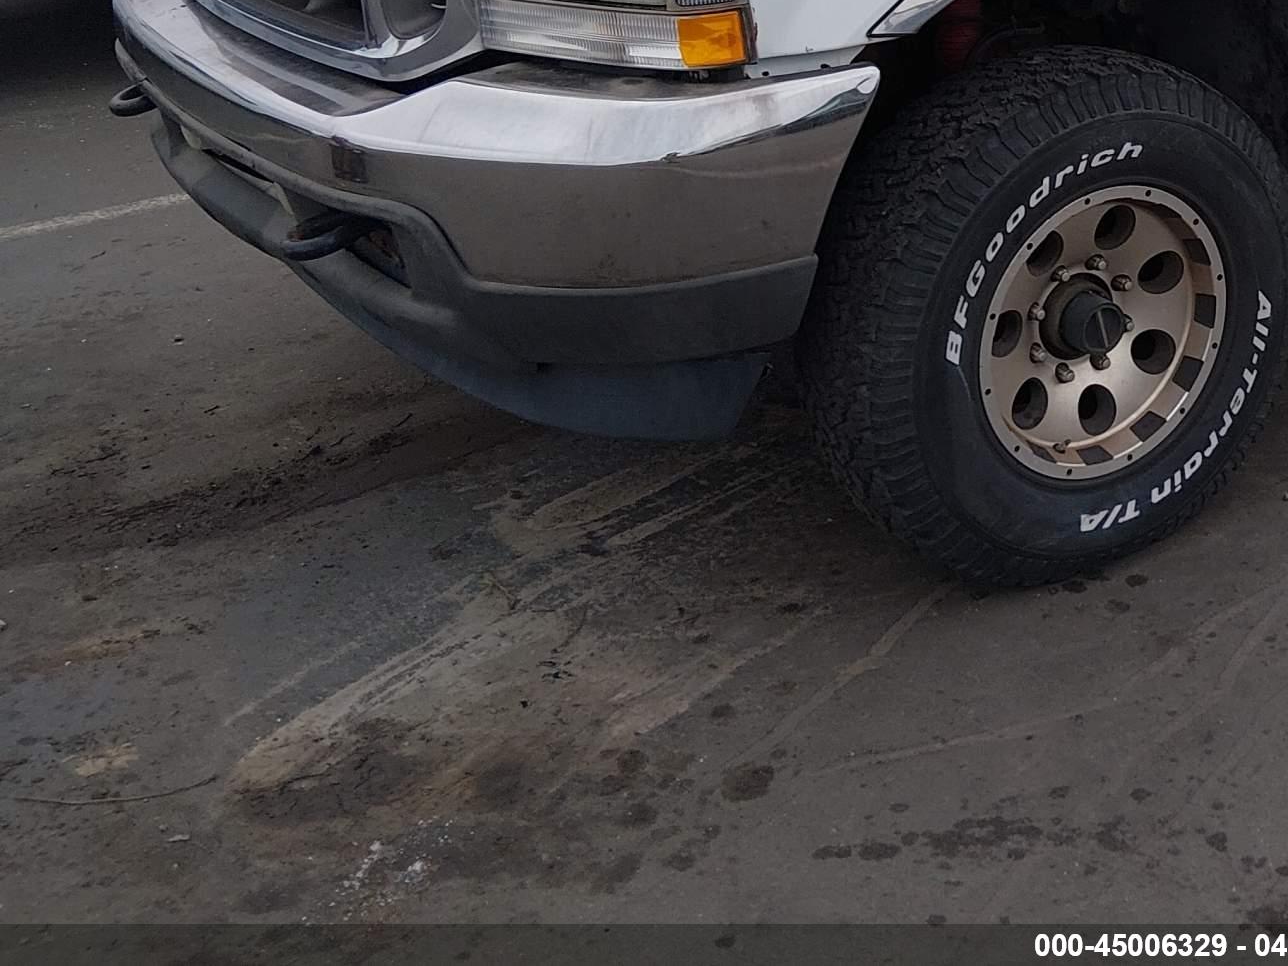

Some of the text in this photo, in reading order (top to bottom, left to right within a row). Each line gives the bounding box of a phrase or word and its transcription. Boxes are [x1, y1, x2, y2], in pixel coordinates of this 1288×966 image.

[945, 141, 1143, 366] BFGoodrich
[1080, 290, 1273, 533] All-Terrain T/A
